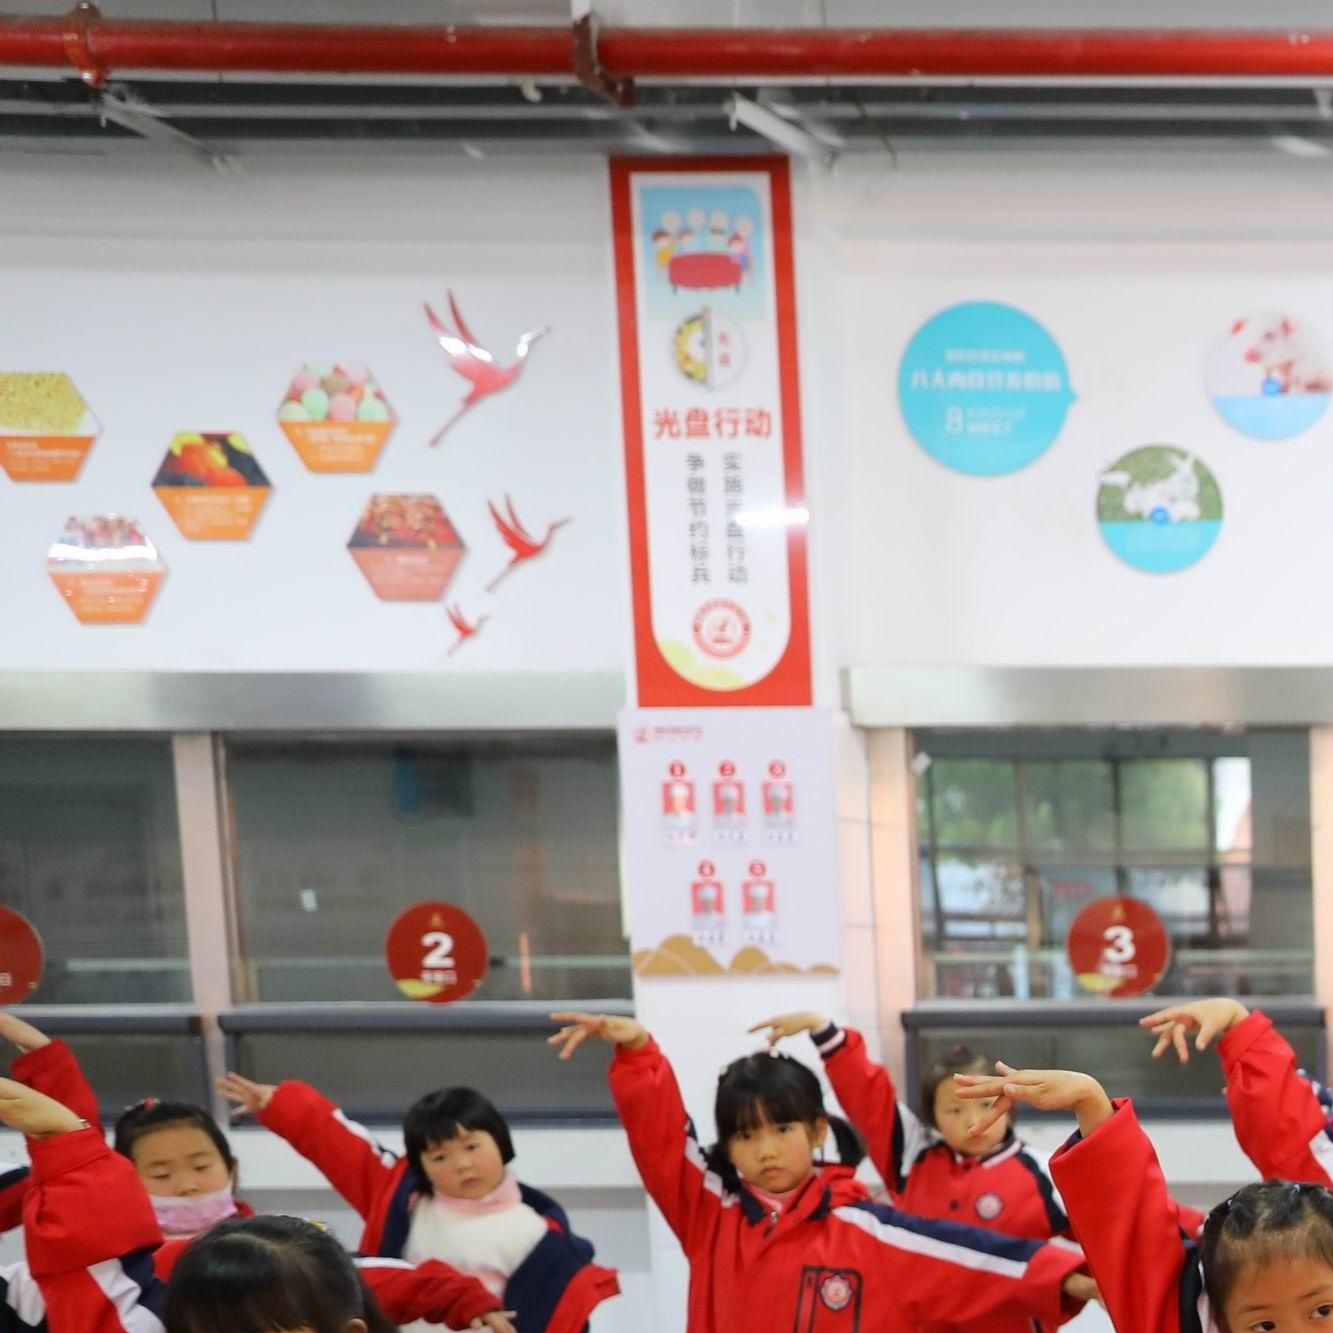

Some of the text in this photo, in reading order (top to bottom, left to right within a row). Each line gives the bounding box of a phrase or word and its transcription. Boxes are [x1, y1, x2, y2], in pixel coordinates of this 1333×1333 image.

[654, 406, 772, 439] 光盘行动
[421, 931, 456, 968] 2
[1103, 924, 1137, 963] 3
